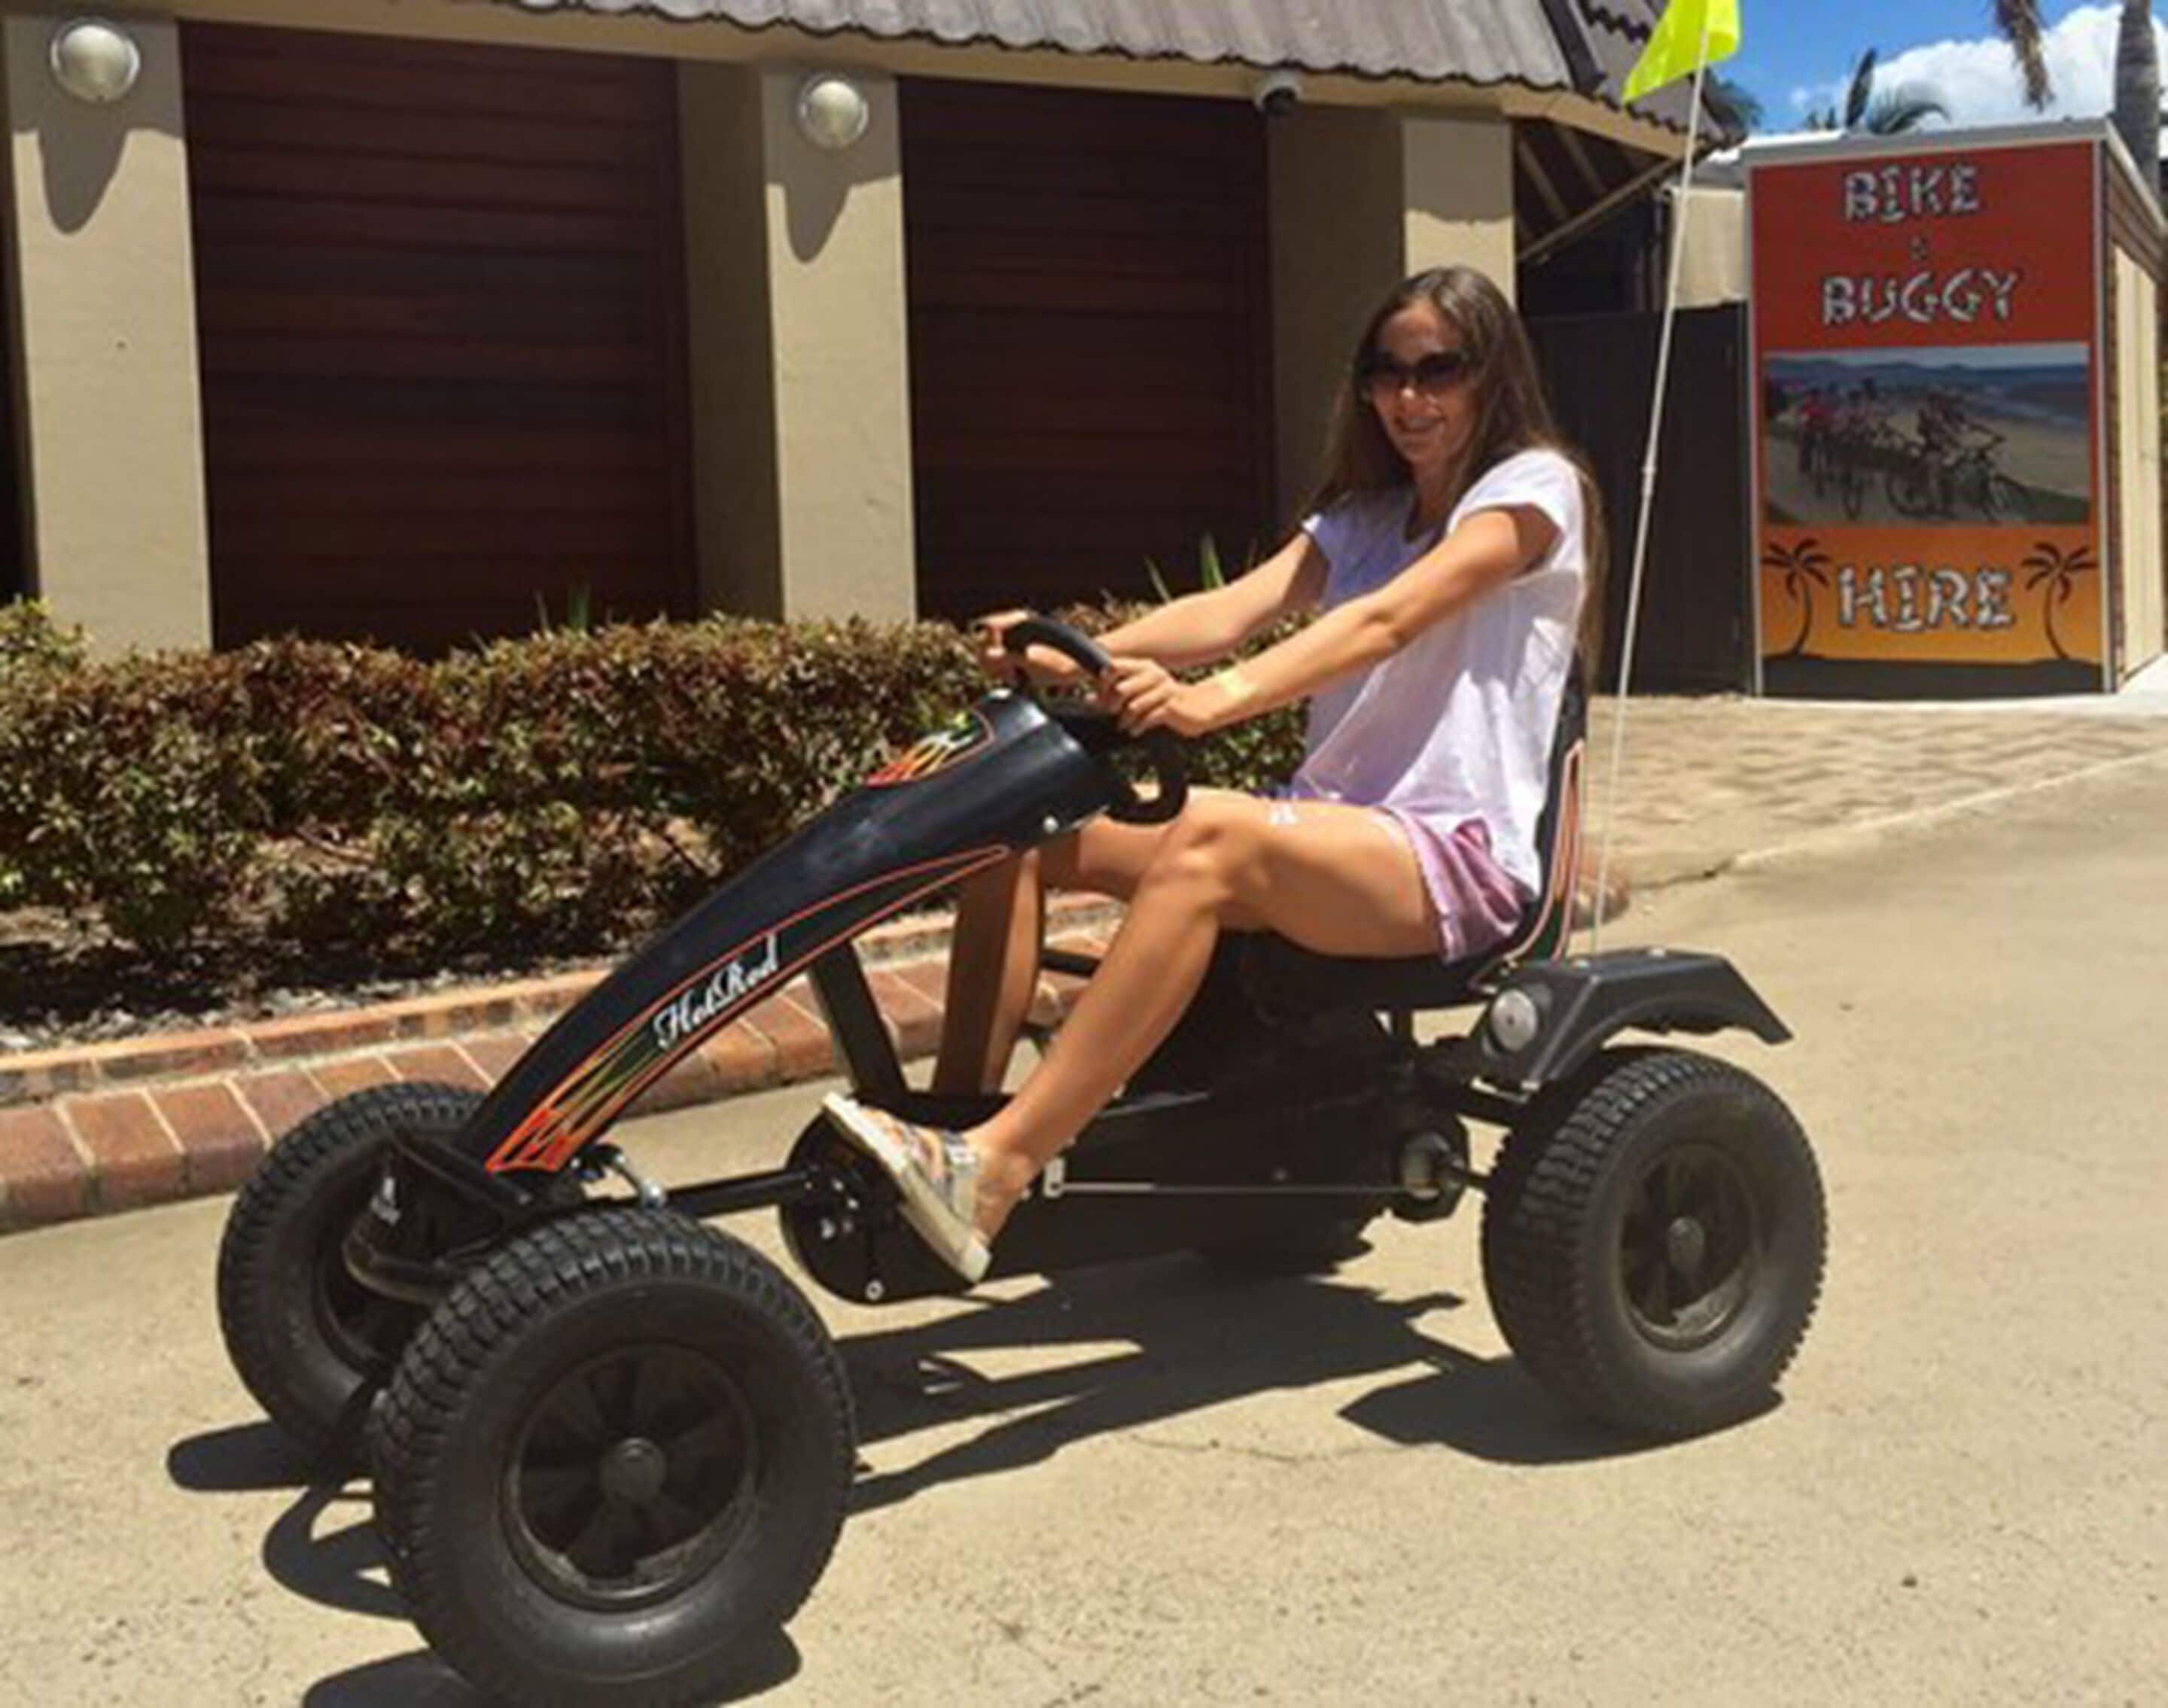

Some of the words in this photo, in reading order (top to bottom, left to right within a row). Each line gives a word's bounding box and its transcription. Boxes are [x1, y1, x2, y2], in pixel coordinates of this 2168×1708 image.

[1844, 166, 1980, 221] BIKE
[1822, 270, 2019, 326] BUGGY
[1837, 565, 2014, 630] HIRE
